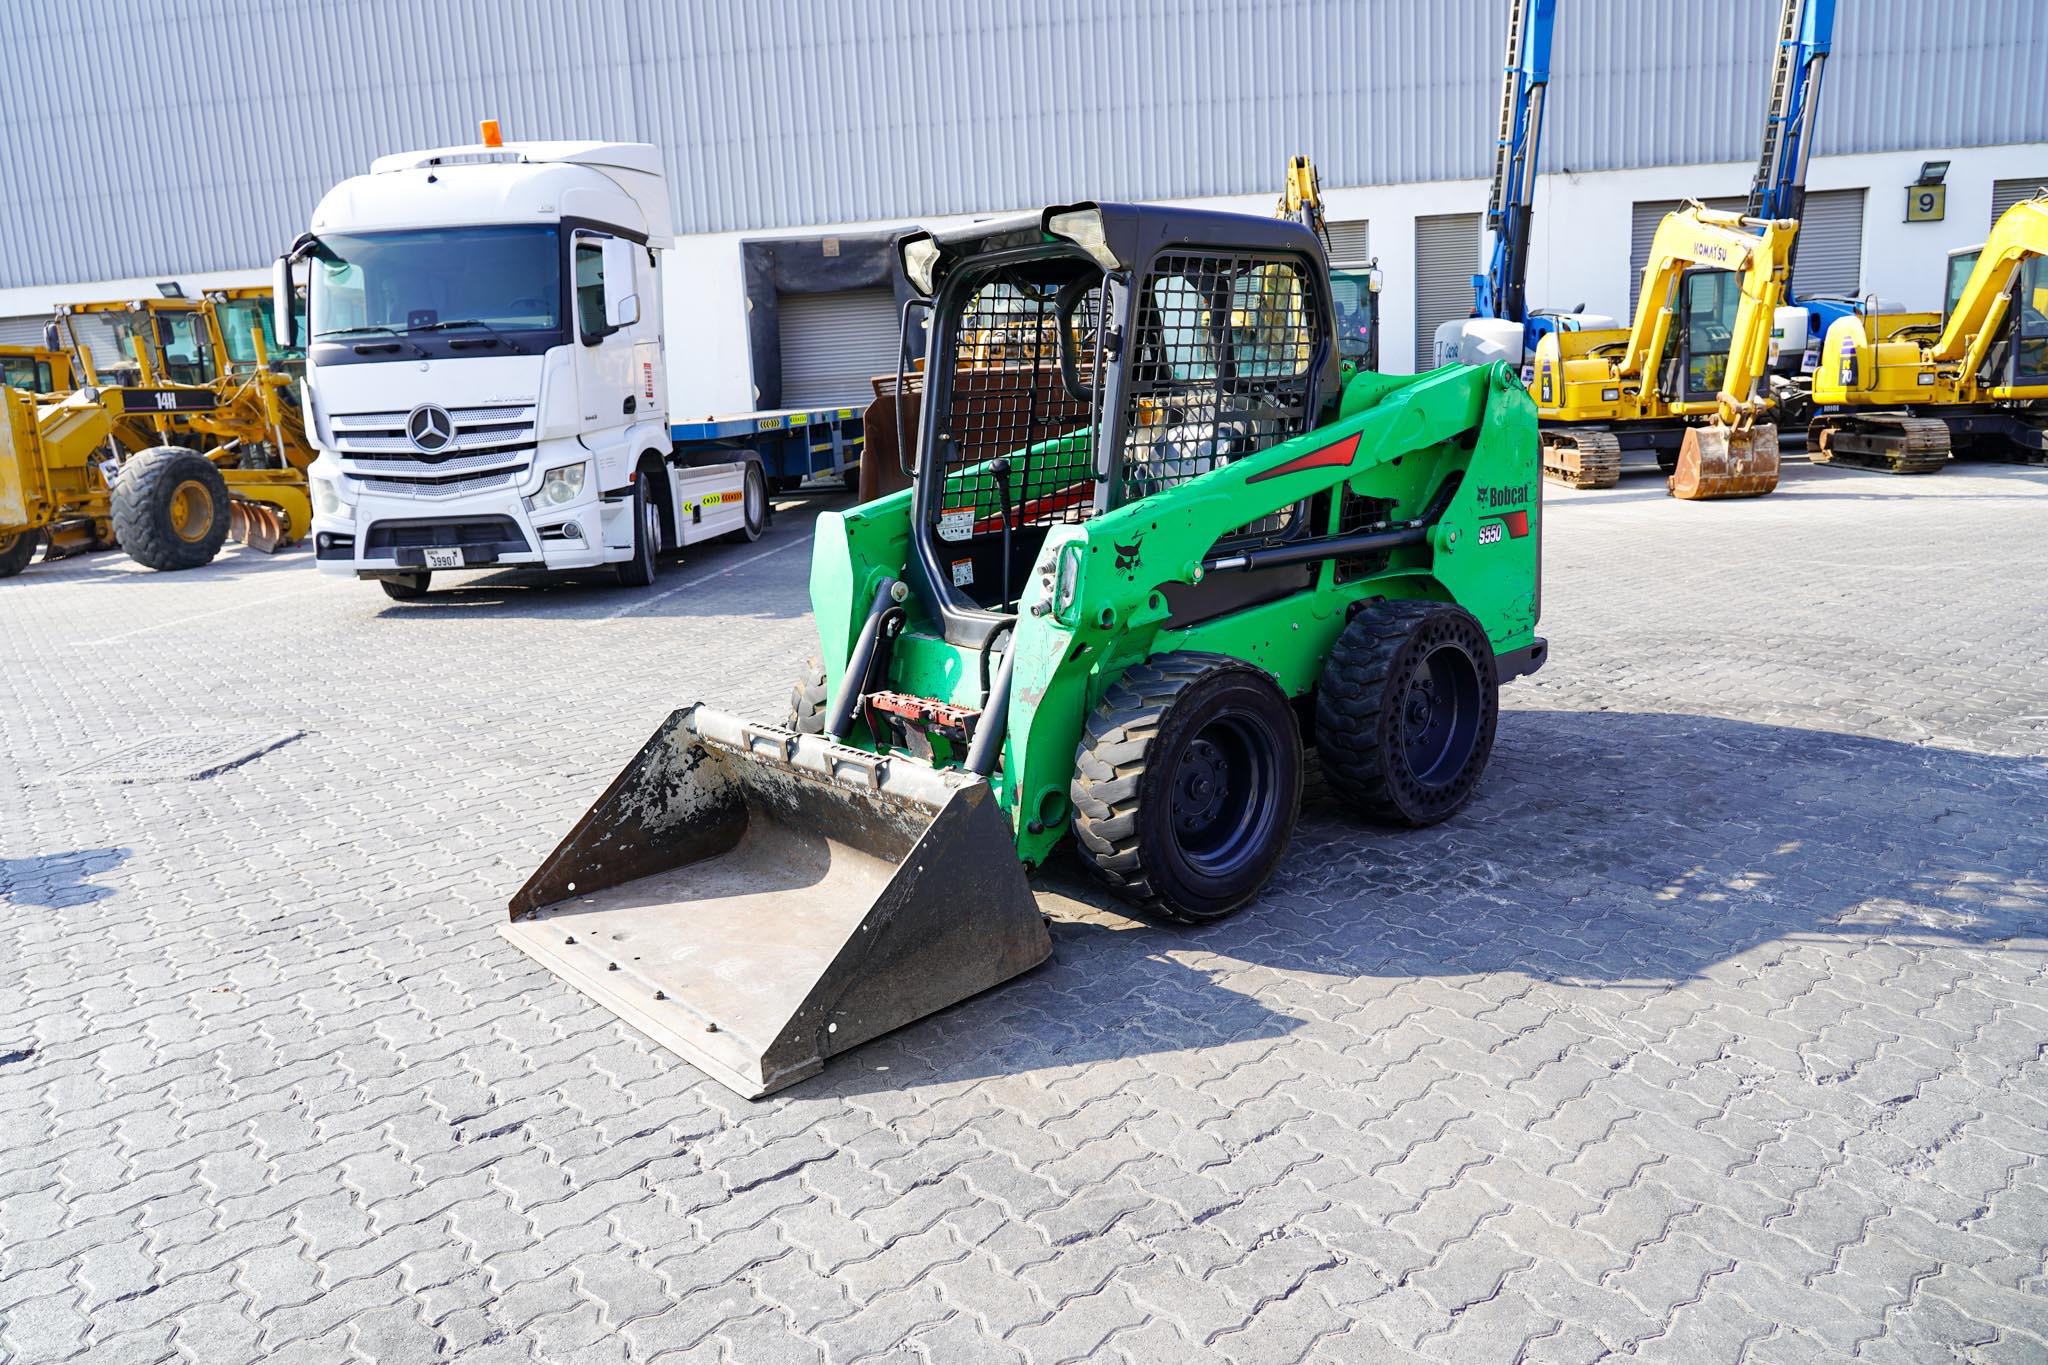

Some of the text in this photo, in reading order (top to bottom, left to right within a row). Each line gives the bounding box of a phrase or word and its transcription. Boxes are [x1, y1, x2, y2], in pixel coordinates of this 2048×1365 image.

[1919, 192, 1935, 213] 9
[1694, 241, 1727, 261] KOMATSU
[1841, 369, 1852, 384] 70
[155, 392, 176, 409] 14H
[1490, 484, 1528, 507] Bobcat
[1478, 523, 1502, 546] S550
[432, 556, 456, 566] 39901
